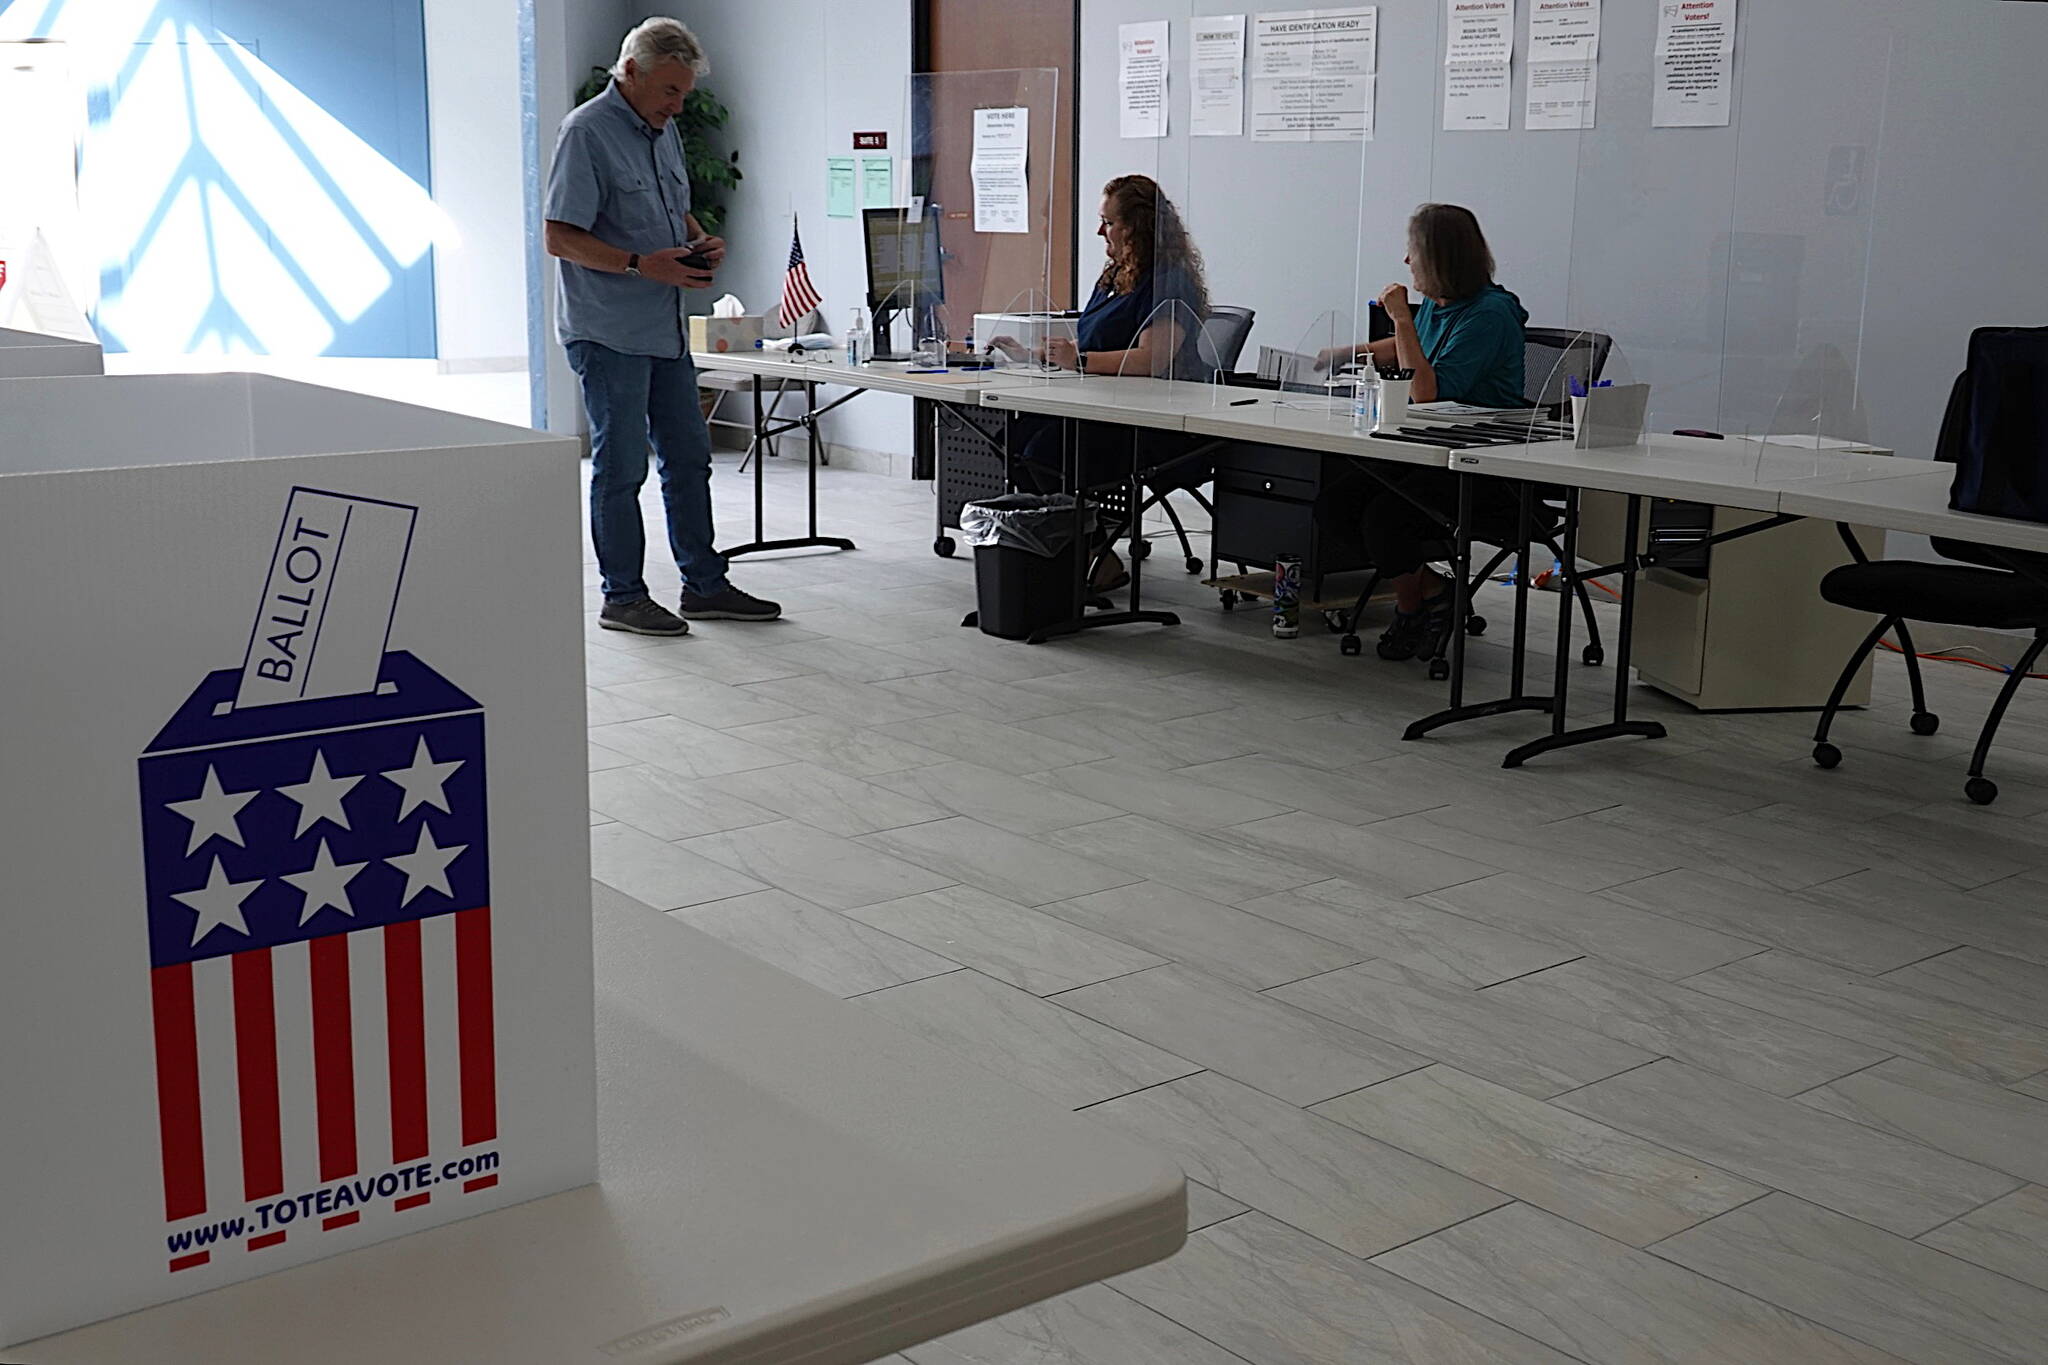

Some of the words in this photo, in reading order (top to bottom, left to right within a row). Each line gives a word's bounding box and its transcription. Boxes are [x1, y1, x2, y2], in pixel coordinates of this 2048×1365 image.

[1455, 3, 1484, 11] Attention
[1540, 2, 1568, 10] Attention
[1681, 2, 1714, 10] Attention
[1684, 13, 1710, 21] Voters!
[1270, 24, 1287, 32] HAVE
[1288, 22, 1336, 31] IDENTIFICATION
[1337, 20, 1360, 28] READY
[257, 517, 329, 683] BALLOT
[167, 1151, 500, 1253] www.TOTEAVOTE.com
